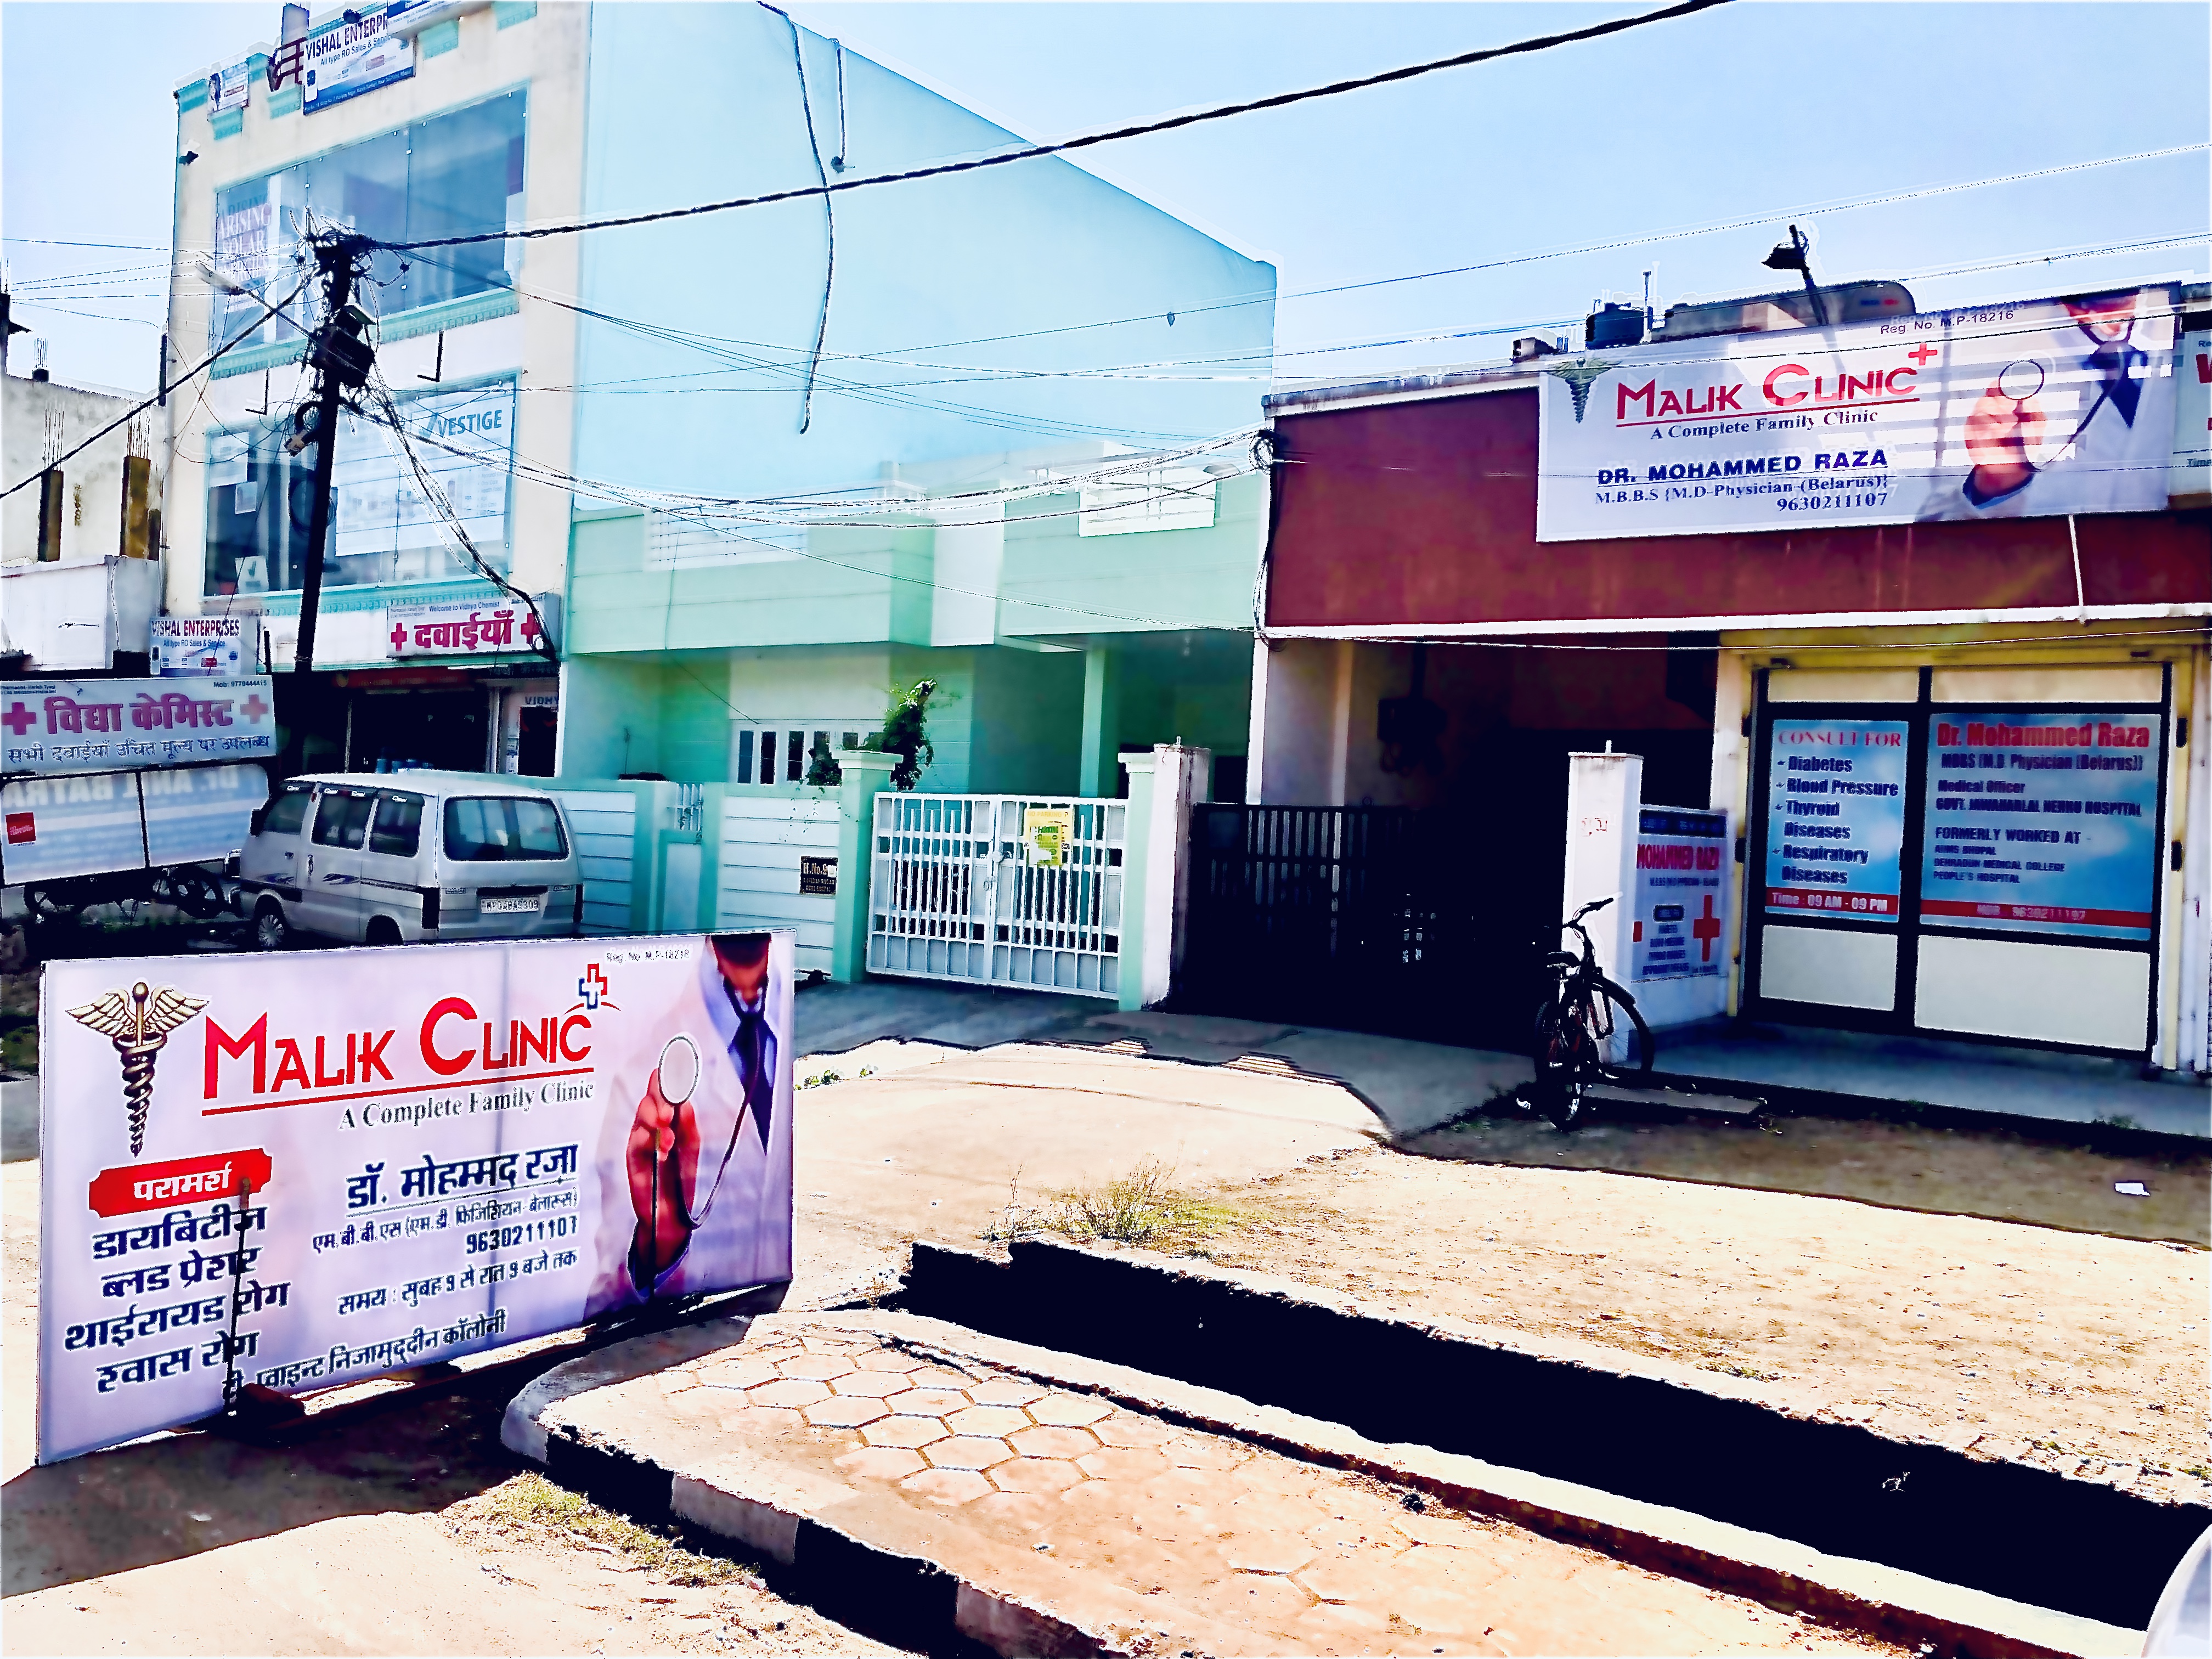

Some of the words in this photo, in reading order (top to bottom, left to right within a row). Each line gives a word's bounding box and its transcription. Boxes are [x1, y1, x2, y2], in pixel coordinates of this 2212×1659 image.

[306, 32, 341, 60] VISHAL
[329, 53, 340, 64] type
[341, 48, 350, 58] RO
[351, 43, 366, 57] Sales
[368, 40, 373, 48] &
[217, 202, 271, 240] ARISING
[1940, 310, 2014, 328] M.P-18216
[1616, 379, 1743, 420] MALIK
[1763, 364, 1918, 407] CLINIC
[438, 410, 503, 437] VESTIGE
[1650, 427, 1663, 440] A
[1667, 421, 1750, 439] Complete
[1756, 414, 1814, 431] Family
[1824, 410, 1878, 426] Clinic
[1598, 467, 1637, 485] DR.
[1648, 455, 1802, 482] MOHAMMED
[1814, 449, 1888, 470] RAZA
[1595, 487, 1659, 505] M.B.B.S
[1776, 493, 1888, 512] 9630211107
[151, 620, 181, 637] VISHAL
[184, 619, 239, 636] ENTERPRISES
[414, 610, 515, 651] दवाईयाँ
[129, 693, 234, 730] केमिस्ट
[1778, 730, 1859, 746] CONSULT
[1865, 732, 1901, 747] FOR
[1937, 723, 1962, 747] Dr.
[1967, 722, 2092, 747] Mohammed
[2097, 722, 2150, 747] Raza
[7, 742, 46, 763] सभी
[114, 738, 156, 757] उचित
[160, 740, 194, 760] मूल्य
[198, 738, 218, 752] पर
[219, 735, 270, 751] उपलब्ध
[1788, 755, 1853, 772] Diabetes
[1786, 777, 1829, 794] Blood
[1831, 778, 1899, 797] Pressure
[1938, 780, 1984, 793] Medical
[1986, 780, 2025, 794] Officer
[1786, 799, 1840, 817] Thyroid
[2042, 800, 2082, 814] NEHRU
[2085, 800, 2142, 817] HOSPITAL
[1784, 822, 1850, 839] Diseases
[1936, 827, 2001, 840] FORMERLY
[2005, 829, 2059, 843] WORKED
[2064, 831, 2081, 844] AT
[1782, 843, 1869, 864] Respiratory
[1983, 860, 2022, 870] MEDICAL
[2026, 861, 2066, 872] COLLEGE
[1781, 865, 1848, 884] Diseases
[1977, 872, 2021, 883] HOSPITAL
[1772, 892, 1799, 906] Time
[1807, 894, 1823, 907] 09
[1824, 895, 1842, 909] AM
[1852, 897, 1866, 910] 09
[1870, 899, 1888, 911] PM
[204, 1011, 395, 1099] MALIK
[420, 997, 592, 1076] CLINIC
[338, 1107, 357, 1130] A
[363, 1096, 462, 1127] Complete
[469, 1086, 535, 1114] Family
[540, 1081, 594, 1104] Clinic
[133, 1161, 232, 1201] परामर्श
[346, 1161, 388, 1208] डॉ.
[400, 1154, 520, 1198] मोहम्मद
[525, 1144, 578, 1180] रजा
[455, 1199, 522, 1226] फिजिशियन
[466, 1215, 577, 1255] 9630211107
[101, 1263, 173, 1297] ब्लड
[338, 1287, 387, 1316] समय
[402, 1276, 442, 1308] सुबह
[445, 1274, 455, 1293] 9
[460, 1263, 475, 1289] से
[479, 1263, 505, 1285] रात
[509, 1261, 518, 1279] 9
[522, 1249, 549, 1275] बजे
[552, 1250, 578, 1269] तक
[64, 1295, 228, 1351] थाईरायड
[239, 1279, 291, 1316] रोग
[442, 1307, 507, 1345] कॉलोनी
[96, 1346, 194, 1394] श्वास
